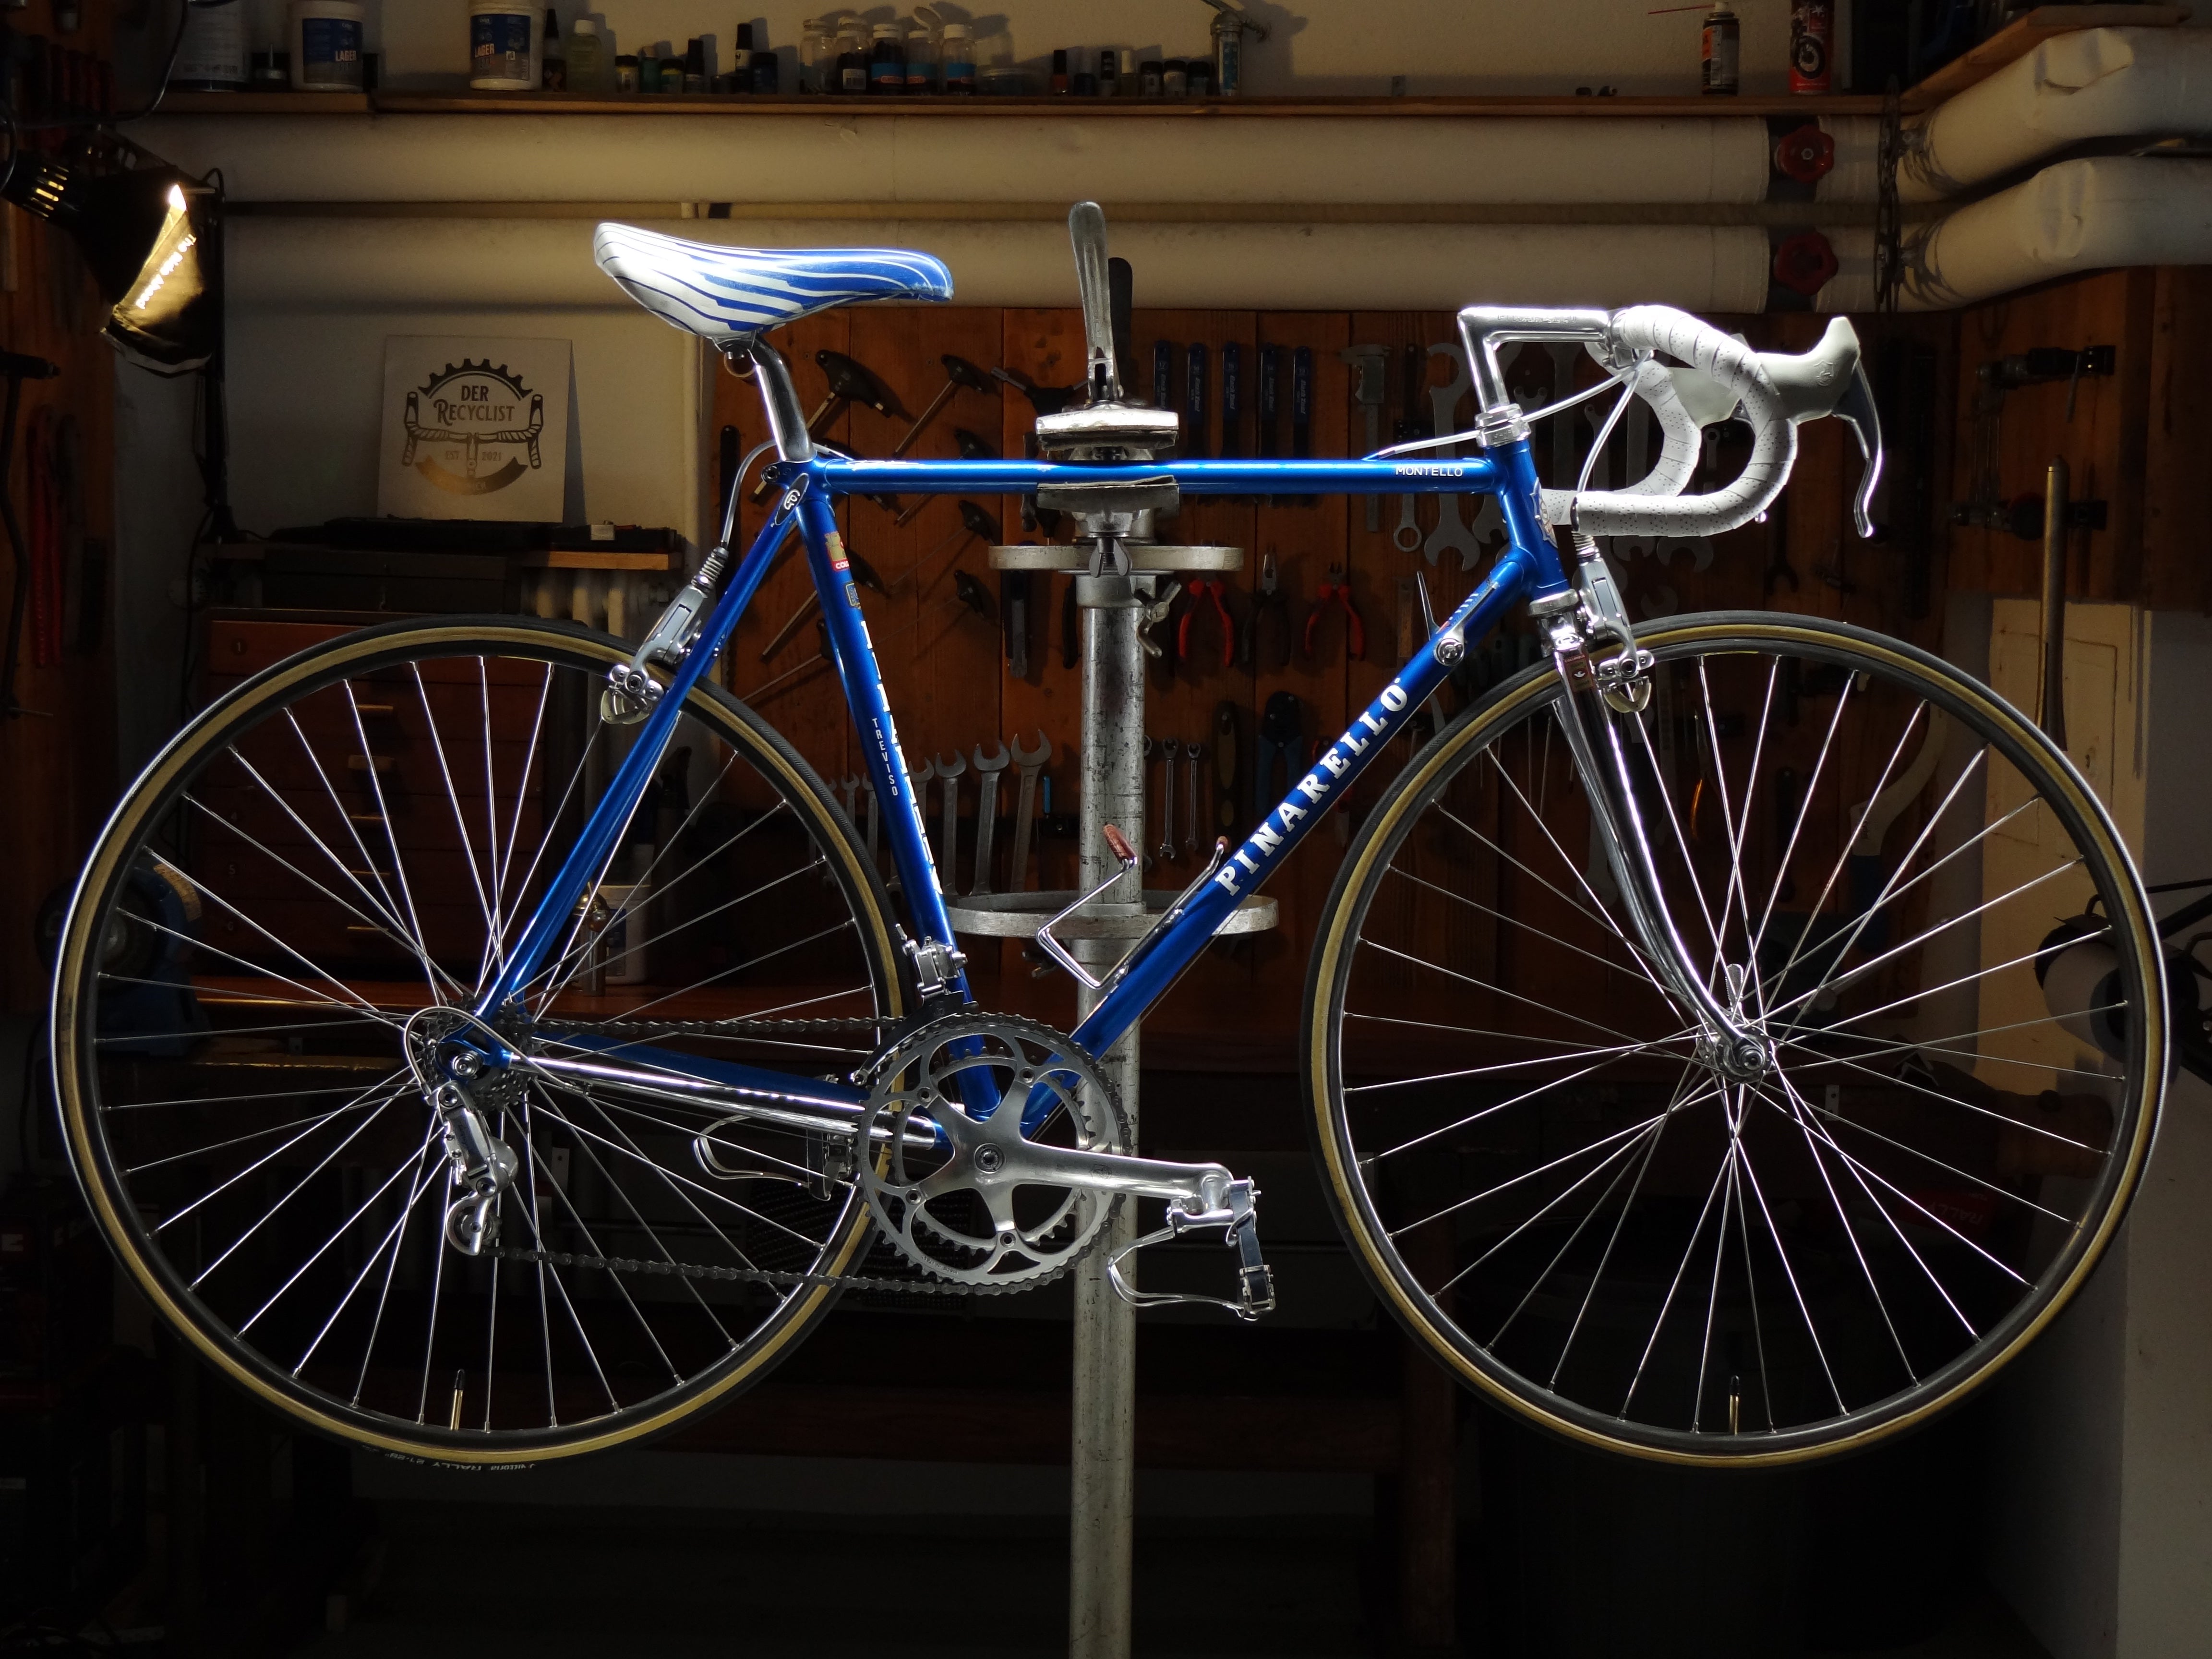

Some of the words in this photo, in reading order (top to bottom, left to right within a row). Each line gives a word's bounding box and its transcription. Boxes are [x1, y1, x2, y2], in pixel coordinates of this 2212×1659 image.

[178, 234, 196, 252] The
[461, 385, 489, 402] DER
[481, 451, 502, 461] 2021
[1395, 466, 1463, 478] MONTELLO
[872, 718, 898, 797] TREVISO
[1214, 685, 1408, 896] PINARELLO
[228, 865, 236, 876] 5
[432, 1461, 482, 1471] RALLY
